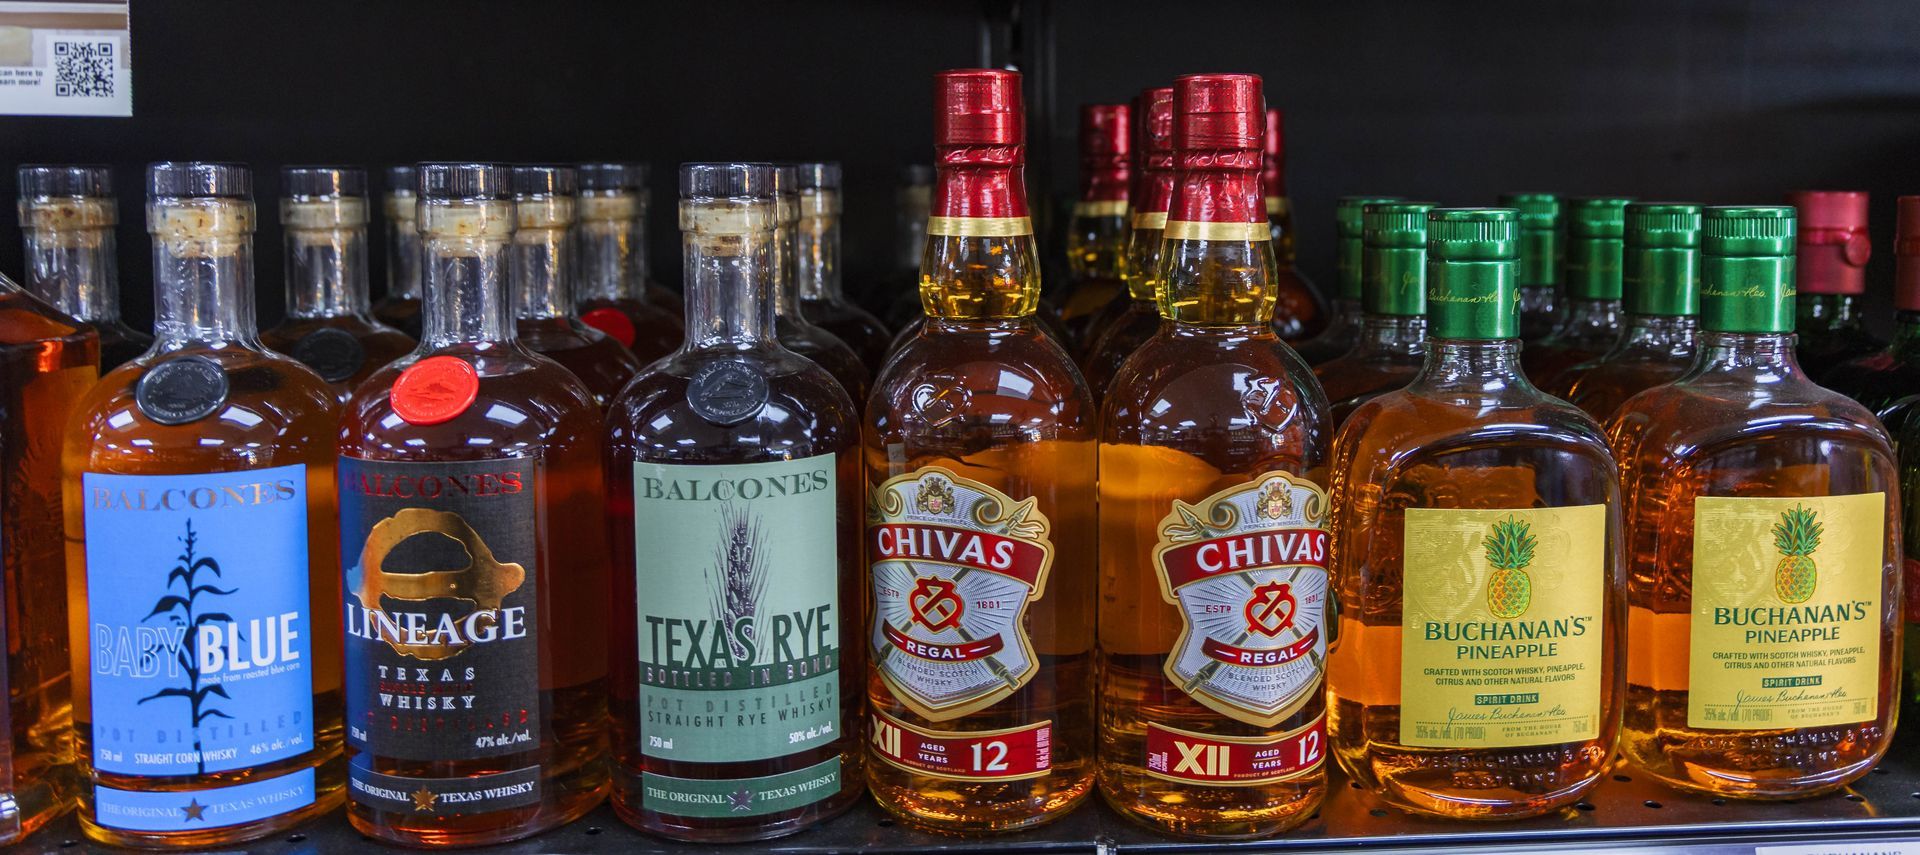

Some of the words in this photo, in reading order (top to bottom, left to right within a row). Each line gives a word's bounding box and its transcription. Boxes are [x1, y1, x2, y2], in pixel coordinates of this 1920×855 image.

[16, 69, 33, 77] here
[35, 69, 43, 77] to
[643, 469, 828, 501] BALCONES
[93, 480, 296, 511] BALCONES
[877, 527, 1015, 570] CHIVAS
[1196, 533, 1326, 572] CHIVAS
[976, 601, 1000, 609] 1801
[347, 603, 527, 646] LINEAGE
[645, 615, 757, 670] TEXAS
[772, 604, 831, 665] RYE
[1745, 626, 1841, 644] PINEAPPLE
[96, 623, 187, 678] BABY
[200, 611, 300, 675] BLUE
[906, 640, 966, 659] REGAL
[1456, 643, 1558, 660] PINEAPPLE
[1240, 649, 1298, 664] REGAL
[1712, 651, 1747, 660] CRAFTED
[1749, 651, 1769, 660] WITH
[1769, 651, 1799, 660] SCOTCH
[1724, 661, 1752, 669] CITRUS
[1753, 661, 1770, 669] AND
[1771, 660, 1795, 669] OTHER
[1796, 659, 1827, 668] NATURAL
[1827, 656, 1857, 666] FLAVORS
[223, 672, 241, 682] from
[270, 665, 286, 675] blue
[286, 662, 300, 671] corn
[378, 665, 475, 682] TEXAS
[647, 666, 733, 688] BOTTLED
[750, 667, 771, 686] IN
[787, 655, 832, 680] BOND
[897, 657, 936, 677] BLENDED
[940, 669, 978, 678] SCOTCH
[1228, 672, 1272, 683] BLENDED
[1275, 665, 1305, 681] SCOTCH
[1423, 667, 1460, 676] CRAFTED
[1461, 668, 1481, 676] WITH
[1482, 668, 1514, 676] SCOTCH
[916, 674, 952, 686] WHISKY
[1252, 681, 1287, 691] WHISKY
[1435, 678, 1464, 686] CITRUS
[1465, 678, 1482, 686] AND
[1483, 677, 1509, 686] OTHER
[1510, 676, 1544, 685] NATURAL
[1544, 673, 1576, 683] FLAVORS
[1763, 678, 1793, 688] SPIRIT
[1795, 676, 1821, 686] DRINK
[379, 693, 476, 710] WHISKY
[648, 694, 683, 712] POT
[706, 682, 832, 713] DISTILLED
[1476, 694, 1508, 705] SPIRIT
[1510, 693, 1537, 704] DRINK
[648, 710, 725, 728] STRAIGHT
[737, 712, 766, 727] RYE
[778, 697, 832, 722] WHISKY
[475, 735, 495, 749] 47%
[649, 735, 662, 748] 750
[663, 737, 673, 750] ml
[788, 730, 806, 744] 50%
[871, 714, 901, 759] XII
[134, 752, 174, 765] STRAIGHT
[175, 751, 201, 764] CORN
[201, 747, 238, 761] WHISKY
[250, 742, 269, 755] 46%
[920, 742, 945, 752] AGED
[971, 741, 1009, 771] 12
[1255, 749, 1280, 758] AGED
[1298, 730, 1319, 766] 12
[918, 752, 948, 764] YEARS
[1173, 740, 1230, 776] XII
[1252, 759, 1281, 769] YEARS
[351, 776, 365, 792] THE
[365, 782, 410, 802] ORIGINAL
[440, 790, 483, 803] TEXAS
[484, 780, 535, 799] WHISKY
[647, 786, 668, 800] THE
[668, 790, 727, 804] ORIGINAL
[758, 785, 797, 801] TEXAS
[797, 771, 837, 794] WHISKY
[211, 799, 254, 815] TEXAS
[257, 785, 306, 807] WHISKY
[101, 801, 121, 815] THE
[122, 803, 183, 818] ORIGINAL
